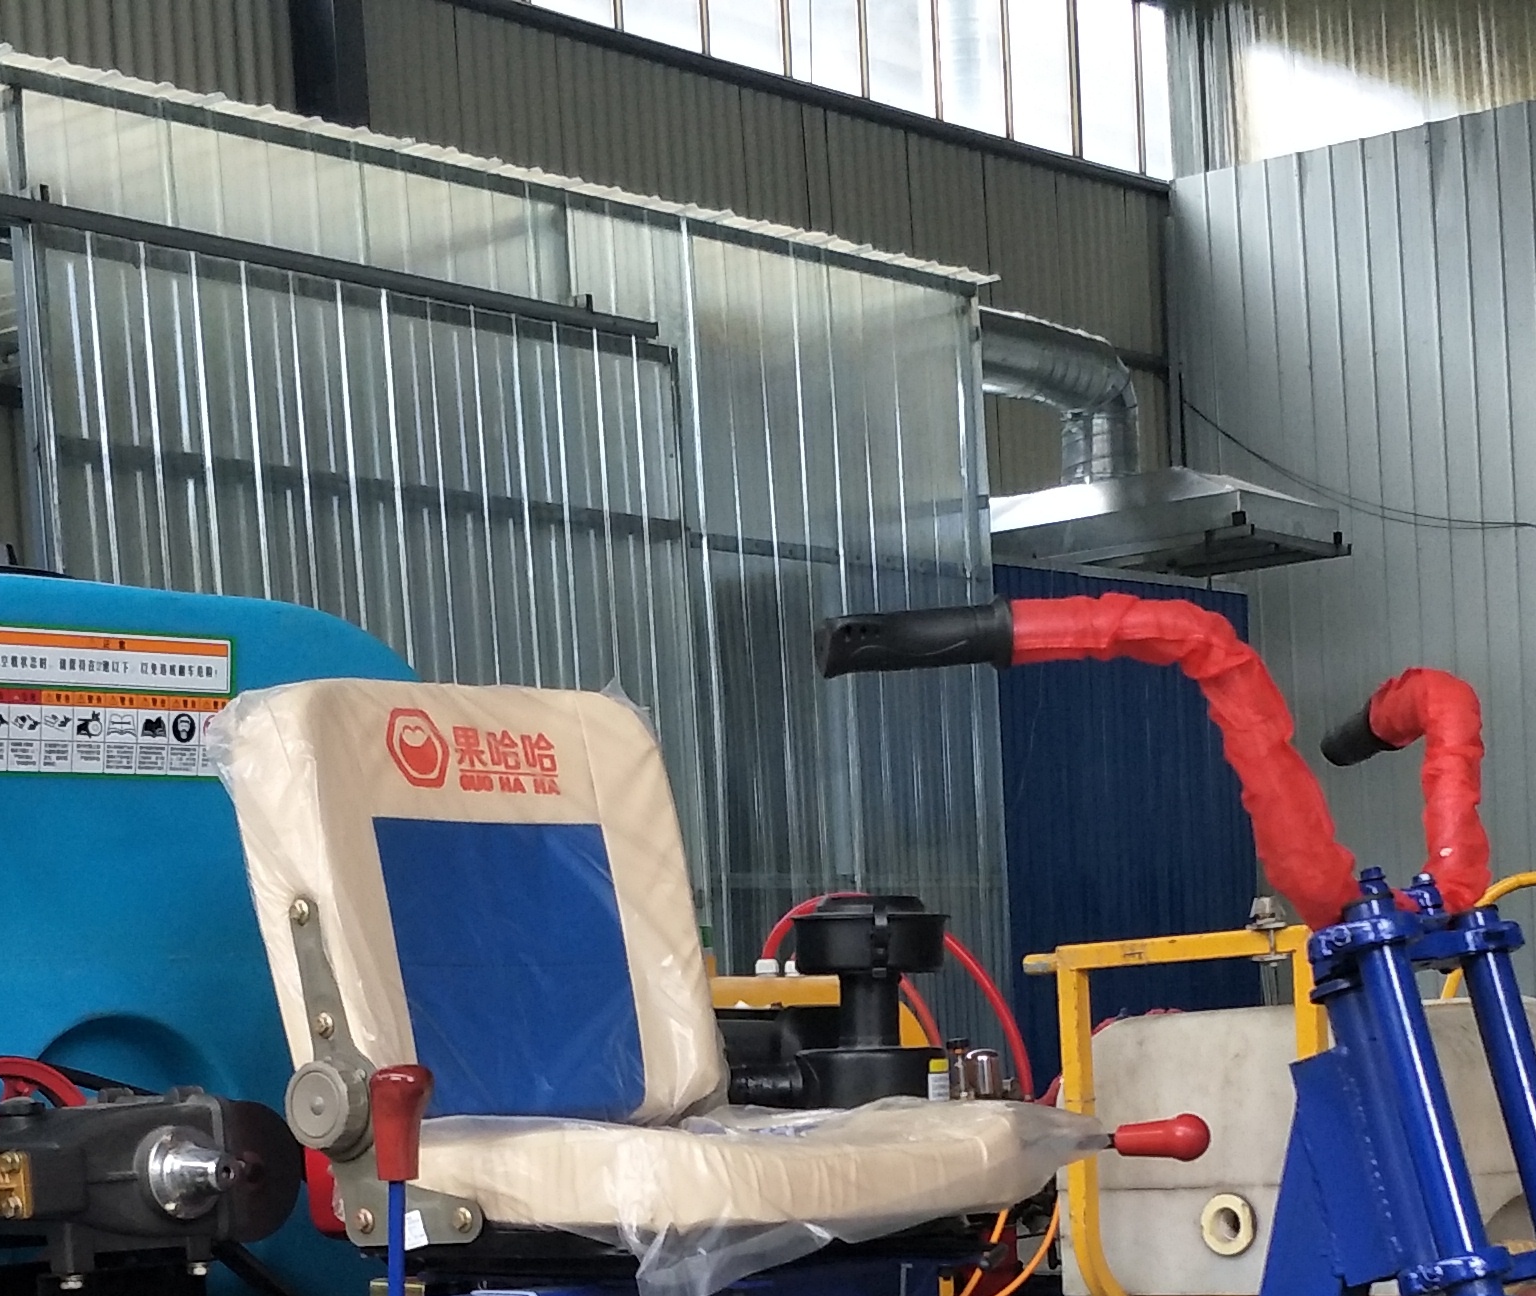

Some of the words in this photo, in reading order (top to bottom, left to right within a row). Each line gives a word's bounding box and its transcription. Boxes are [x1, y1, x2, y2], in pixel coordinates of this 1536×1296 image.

[454, 726, 557, 772] 果哈哈
[459, 775, 493, 792] GUO
[499, 775, 527, 795] HA
[533, 776, 561, 796] HA
